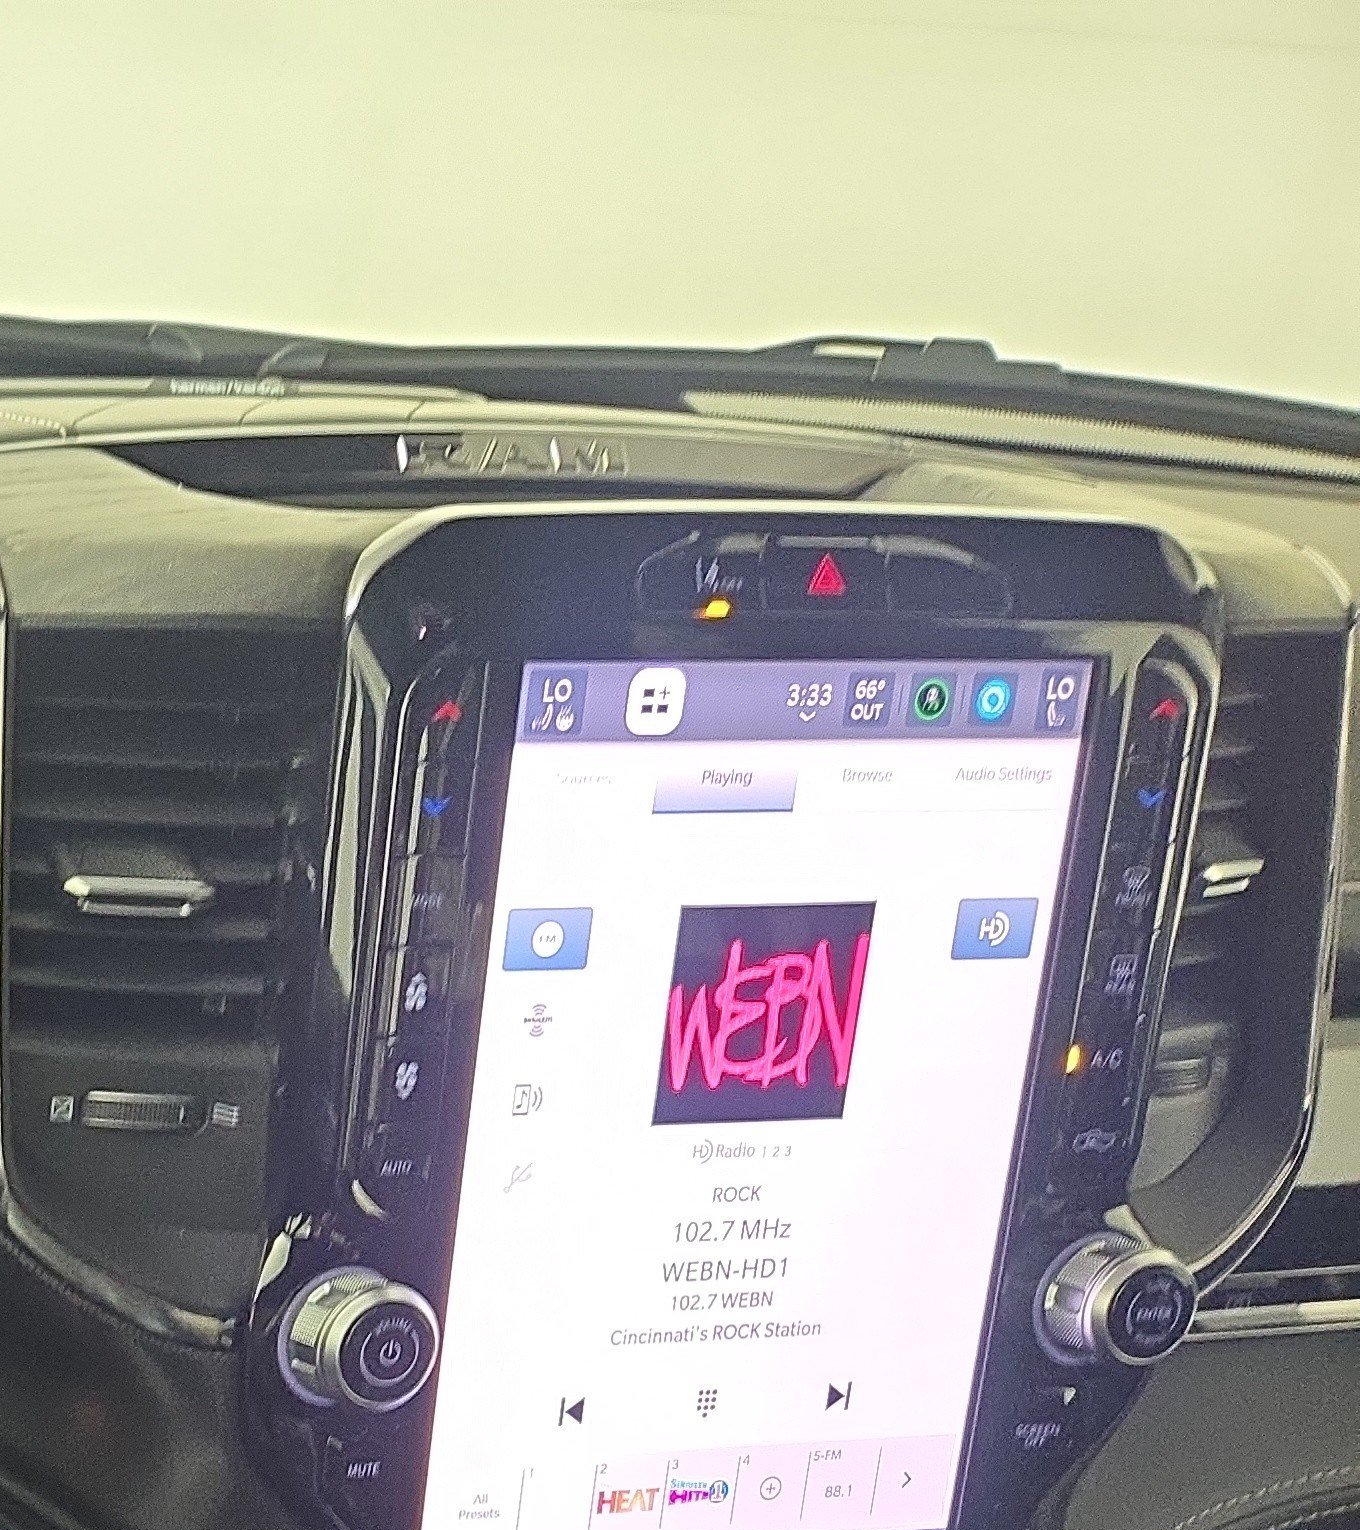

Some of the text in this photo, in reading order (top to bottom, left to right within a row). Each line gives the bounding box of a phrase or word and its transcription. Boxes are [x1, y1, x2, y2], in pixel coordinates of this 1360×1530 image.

[542, 678, 573, 703] LO
[787, 683, 832, 707] 3:33
[855, 679, 886, 700] 66°
[1046, 677, 1075, 700] LO
[851, 703, 884, 721] OUT
[701, 769, 754, 788] Playing
[842, 767, 893, 783] Browse
[956, 766, 1052, 786] Audio Settings
[668, 931, 870, 1094] WEBN
[773, 1145, 781, 1158] 2
[785, 1144, 792, 1158] 3
[712, 1185, 763, 1204] ROCK
[674, 1218, 792, 1244] 102.7 MHz
[663, 1257, 788, 1283] WEBN-HD1
[672, 1291, 774, 1312] 102.7 WEBN
[610, 1320, 822, 1346] Cincinnati's ROCK Station
[599, 1463, 608, 1475] 2
[672, 1459, 679, 1470] 3
[742, 1455, 750, 1466] 4
[473, 1493, 488, 1505] All
[824, 1484, 852, 1498] 88.1
[596, 1487, 660, 1515] HEAT
[458, 1507, 500, 1521] Presets
